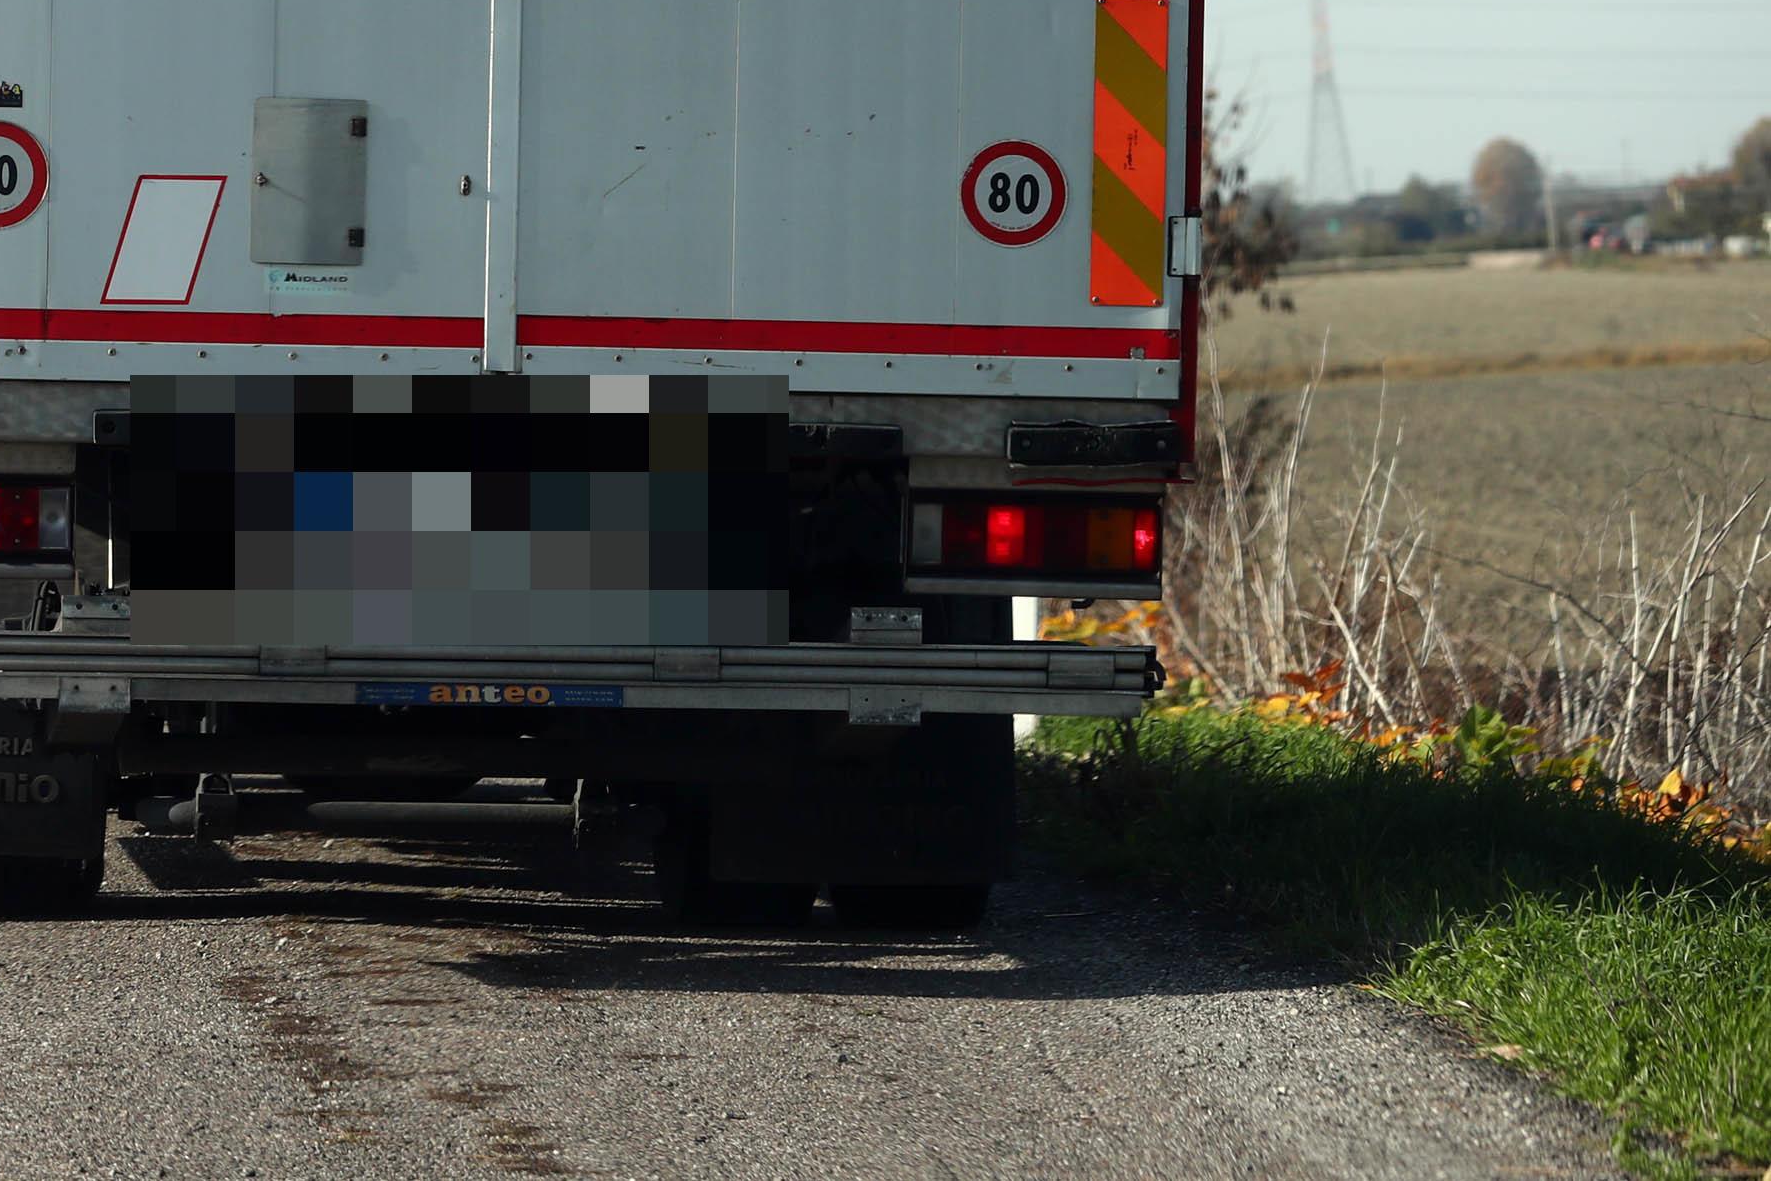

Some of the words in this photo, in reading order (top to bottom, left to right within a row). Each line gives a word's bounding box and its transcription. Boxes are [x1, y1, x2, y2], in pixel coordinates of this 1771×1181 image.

[988, 172, 1040, 214] 80
[284, 272, 349, 283] MIDLAND
[427, 683, 551, 706] anteo
